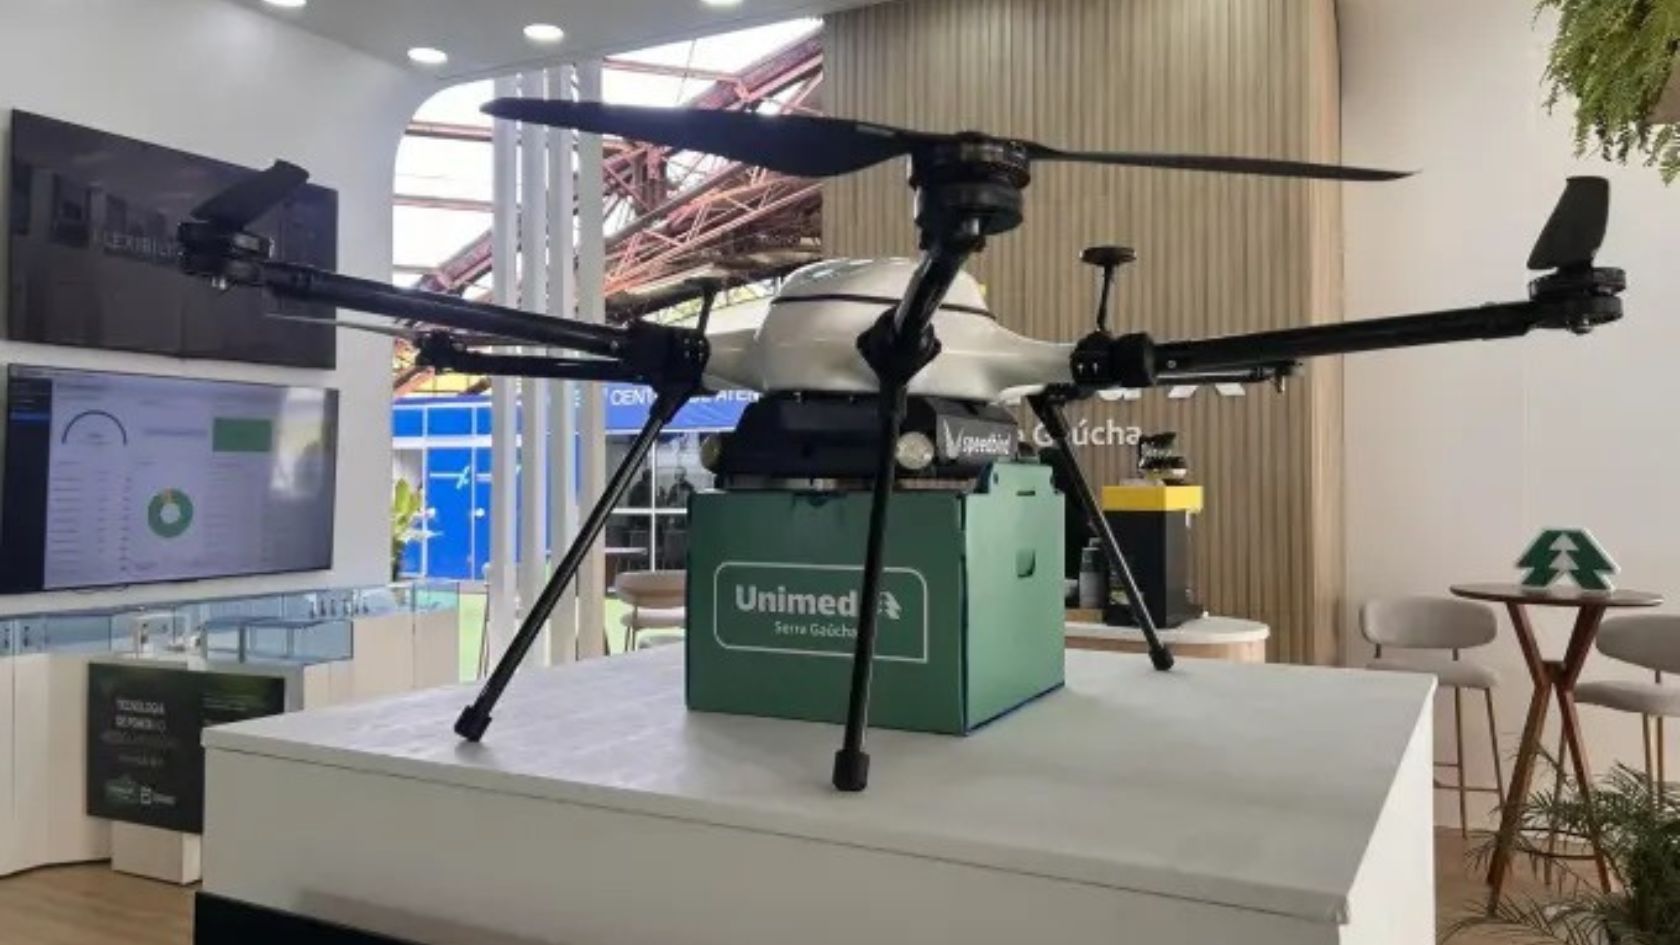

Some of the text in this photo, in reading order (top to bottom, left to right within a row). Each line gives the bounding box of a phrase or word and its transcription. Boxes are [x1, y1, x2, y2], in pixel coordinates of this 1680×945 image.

[1033, 418, 1142, 447] Gúcha
[735, 584, 858, 618] Unimed
[774, 620, 858, 638] Serra Gaúcha
